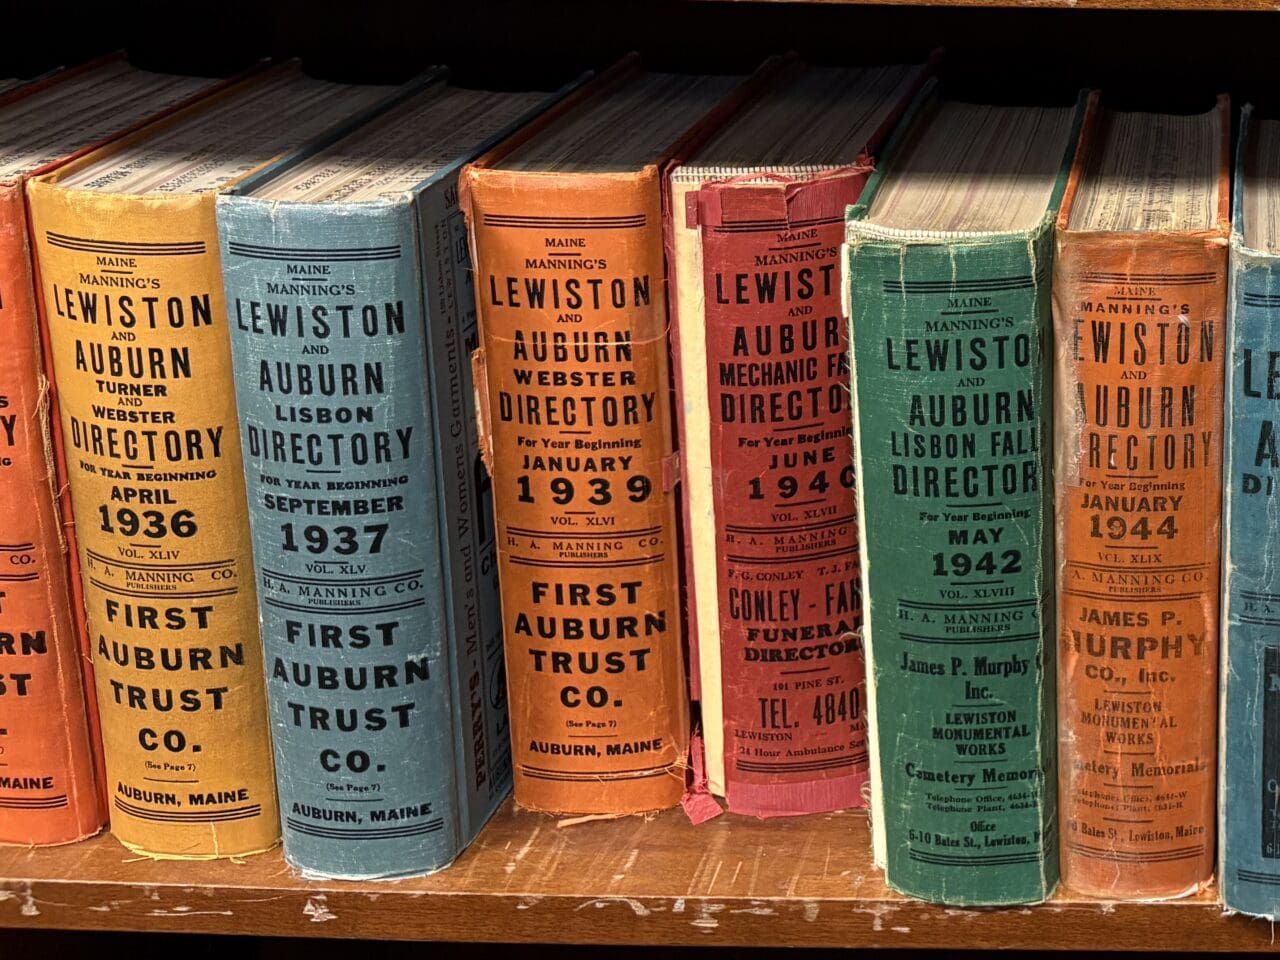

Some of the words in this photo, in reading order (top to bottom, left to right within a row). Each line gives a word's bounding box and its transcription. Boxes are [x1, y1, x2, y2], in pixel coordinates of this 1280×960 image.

[287, 264, 331, 274] MAINE
[79, 273, 160, 289] MANNING'S
[54, 283, 212, 329] LEWISTON
[513, 368, 636, 386] WEBSTER
[96, 380, 167, 396] TURNER
[276, 405, 373, 423] LISBON
[71, 415, 224, 462] DIRECTORY
[517, 436, 537, 447] For
[541, 438, 570, 448] Year
[575, 438, 643, 451] Beginning
[522, 455, 632, 472] JANUARY
[770, 446, 835, 469] JUNE
[111, 486, 176, 504] APRIL
[1081, 494, 1183, 512] JANUARY
[265, 494, 404, 515] SEPTEMBER
[99, 505, 197, 538] 1936
[550, 517, 577, 525] VOL.
[586, 517, 615, 525] XLVI
[1091, 515, 1178, 540] 1944
[281, 523, 389, 555] 1937
[949, 527, 1004, 545] MAY
[933, 550, 1022, 576] 1942
[1080, 608, 1149, 627] JAMES
[1161, 611, 1182, 626] P.
[286, 620, 399, 649] FIRST
[110, 680, 228, 712] TRUST
[965, 681, 993, 699] Inc.
[759, 698, 799, 729] TEL.
[813, 692, 860, 722] 4840
[1094, 698, 1161, 714] LEWISTON
[735, 730, 793, 741] LEWISTON
[933, 724, 1031, 740] MONUMENTAL
[145, 761, 161, 769] (See
[164, 763, 185, 771] Page
[187, 763, 196, 771] 7)
